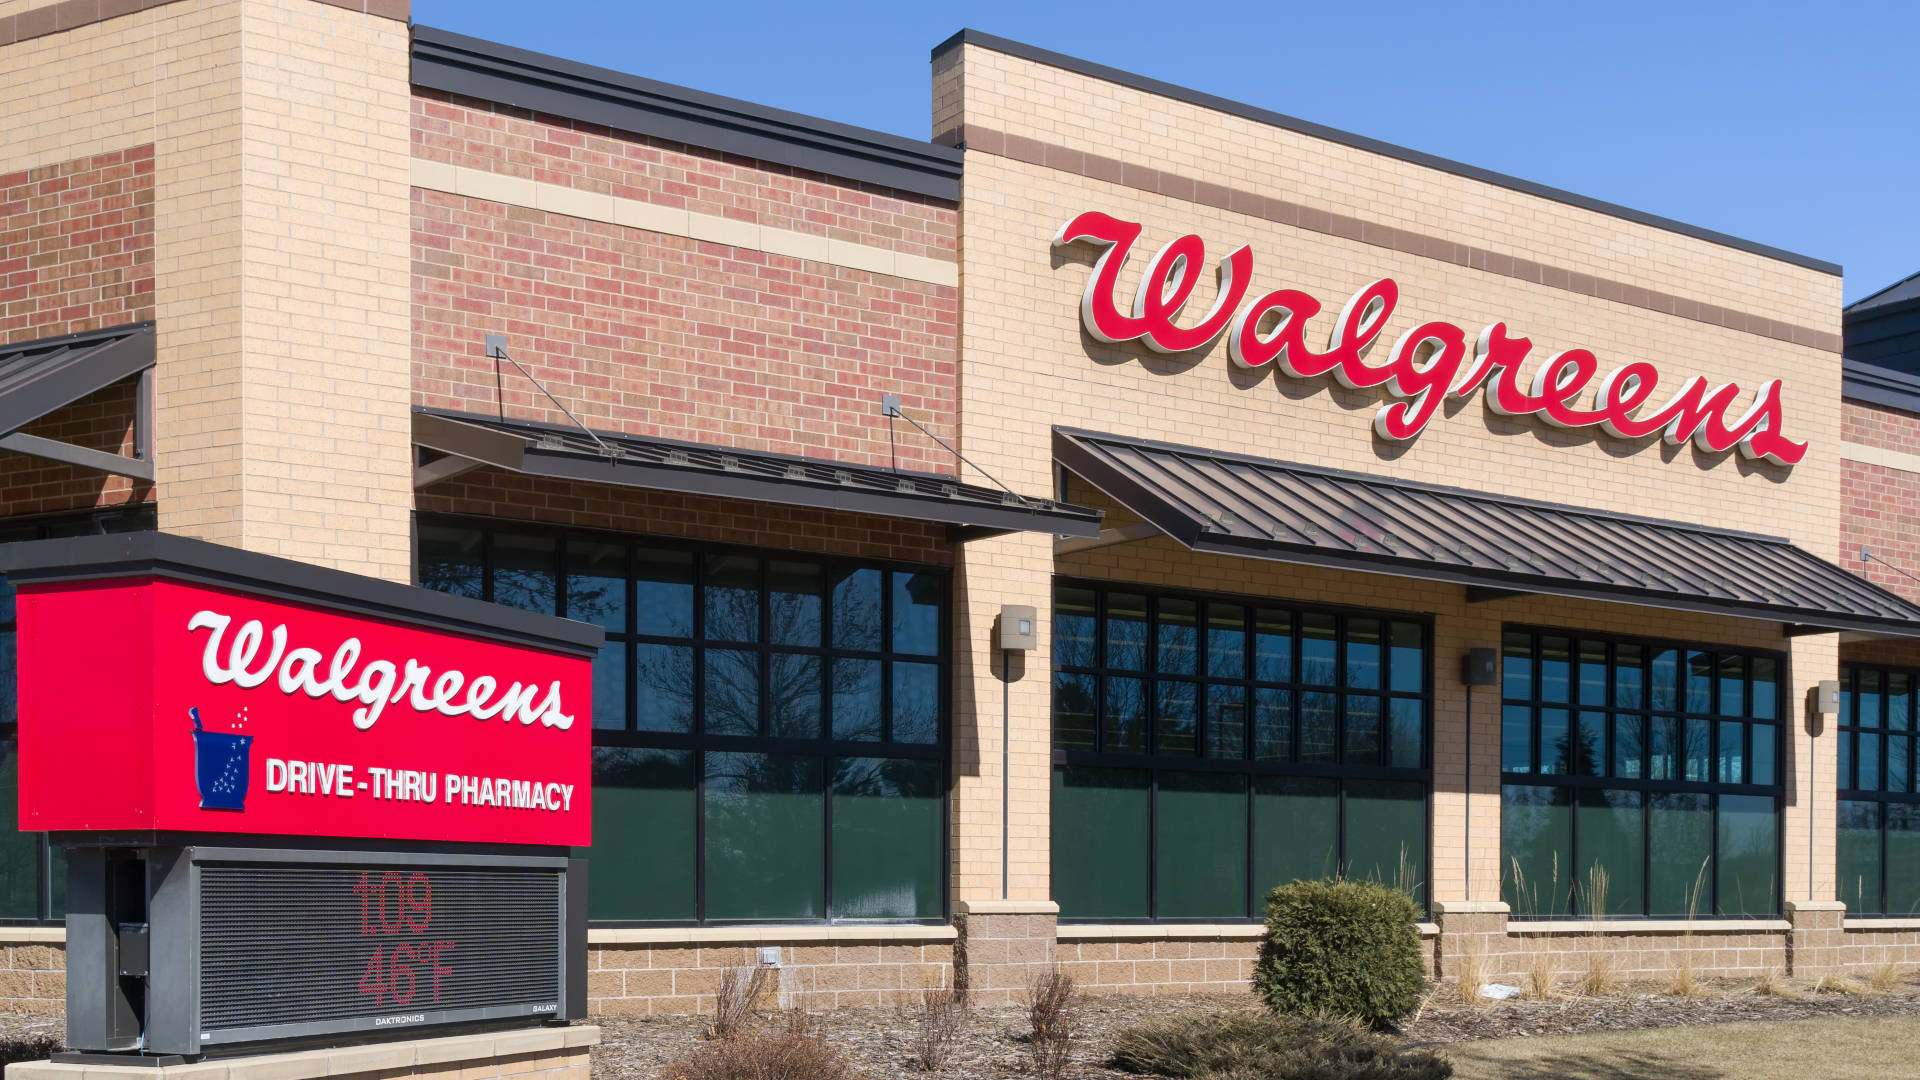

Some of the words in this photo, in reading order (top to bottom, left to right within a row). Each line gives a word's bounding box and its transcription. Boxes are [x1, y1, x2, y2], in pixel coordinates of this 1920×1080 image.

[1054, 210, 1809, 466] Walgreens
[187, 609, 575, 731] Walgreens
[266, 757, 437, 804] DRIVE-THRU
[445, 773, 575, 812] PHARMACY
[375, 1014, 425, 1026] DAKTRONICS
[532, 1003, 558, 1013] GALAXY
